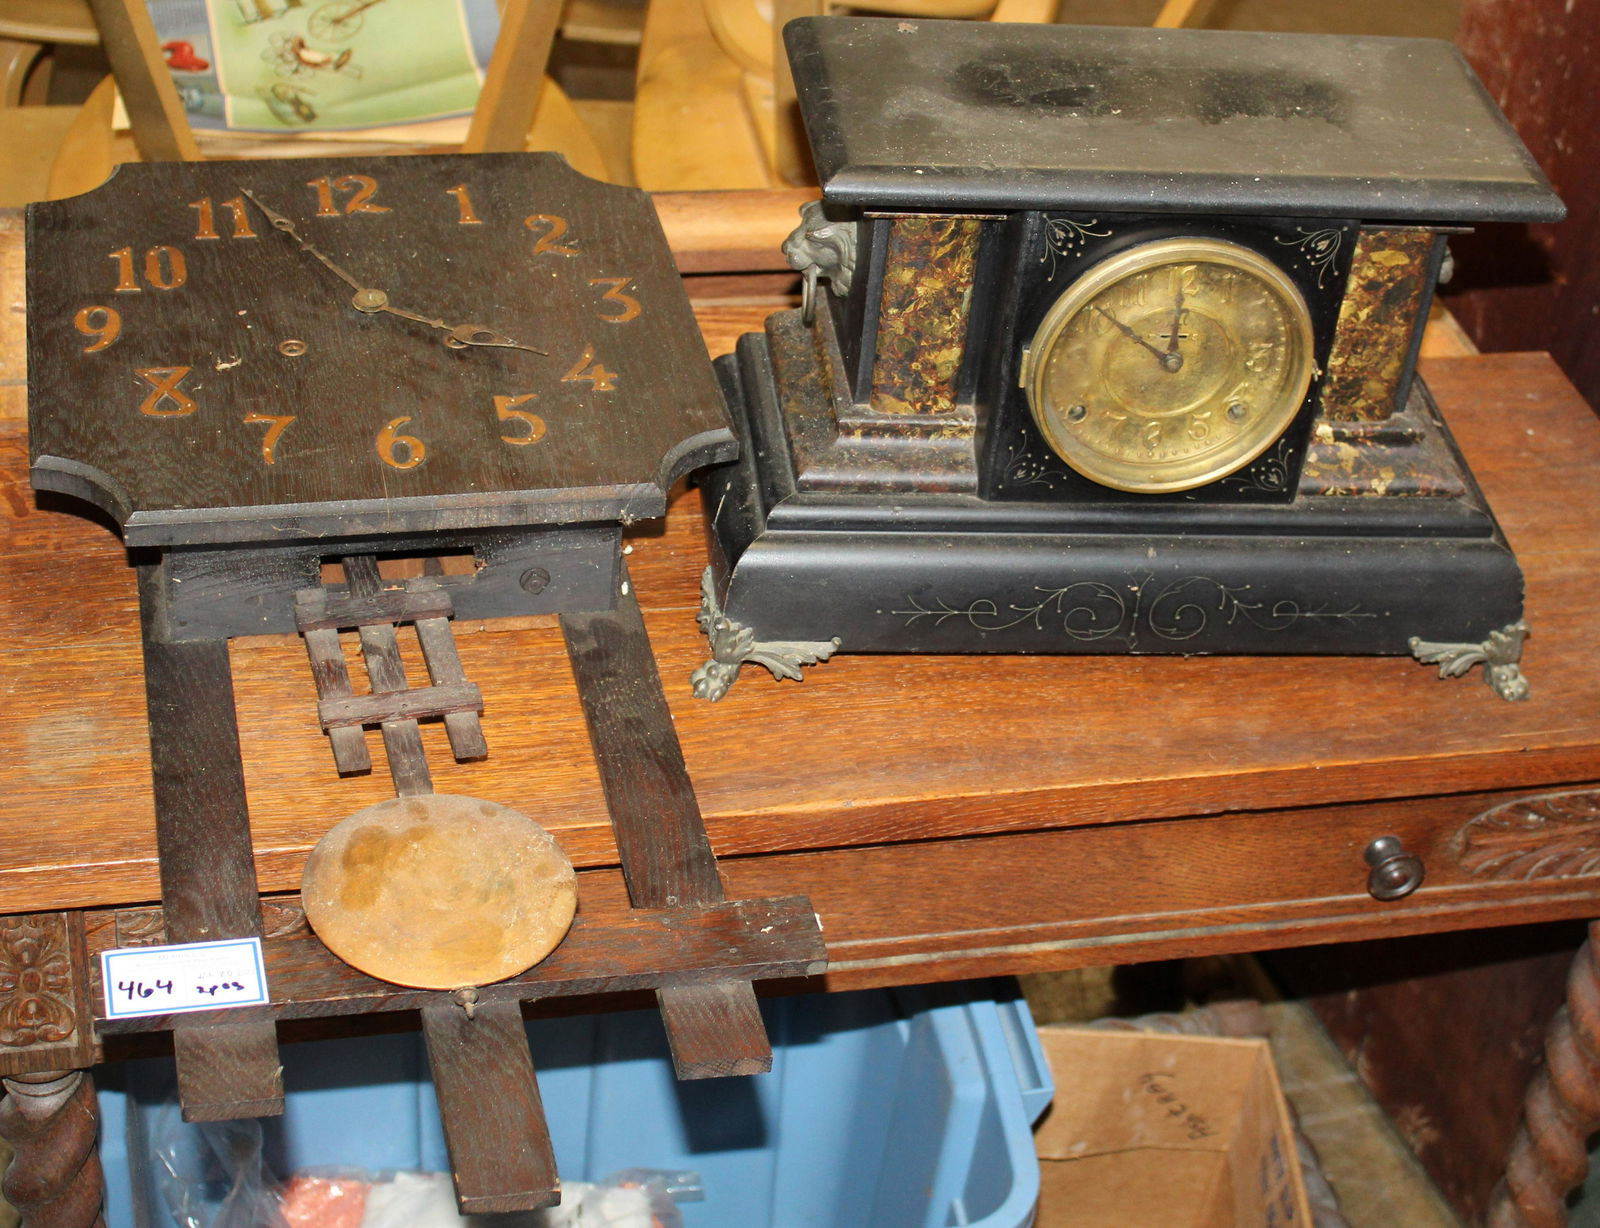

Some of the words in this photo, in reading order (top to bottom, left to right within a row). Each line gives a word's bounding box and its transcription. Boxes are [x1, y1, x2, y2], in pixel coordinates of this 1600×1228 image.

[188, 197, 257, 239] 11
[308, 174, 393, 218] 12
[446, 184, 483, 225] 1
[524, 214, 581, 258] 2
[109, 245, 188, 292] 10
[1166, 264, 1200, 296] 12
[588, 277, 642, 324] 3
[75, 305, 123, 354] 9
[135, 365, 197, 417] 8
[560, 345, 619, 392] 4
[243, 413, 296, 466] 7
[377, 416, 427, 469] 6
[493, 394, 547, 446] 5
[1187, 410, 1214, 441] 5
[118, 979, 173, 1001] 464
